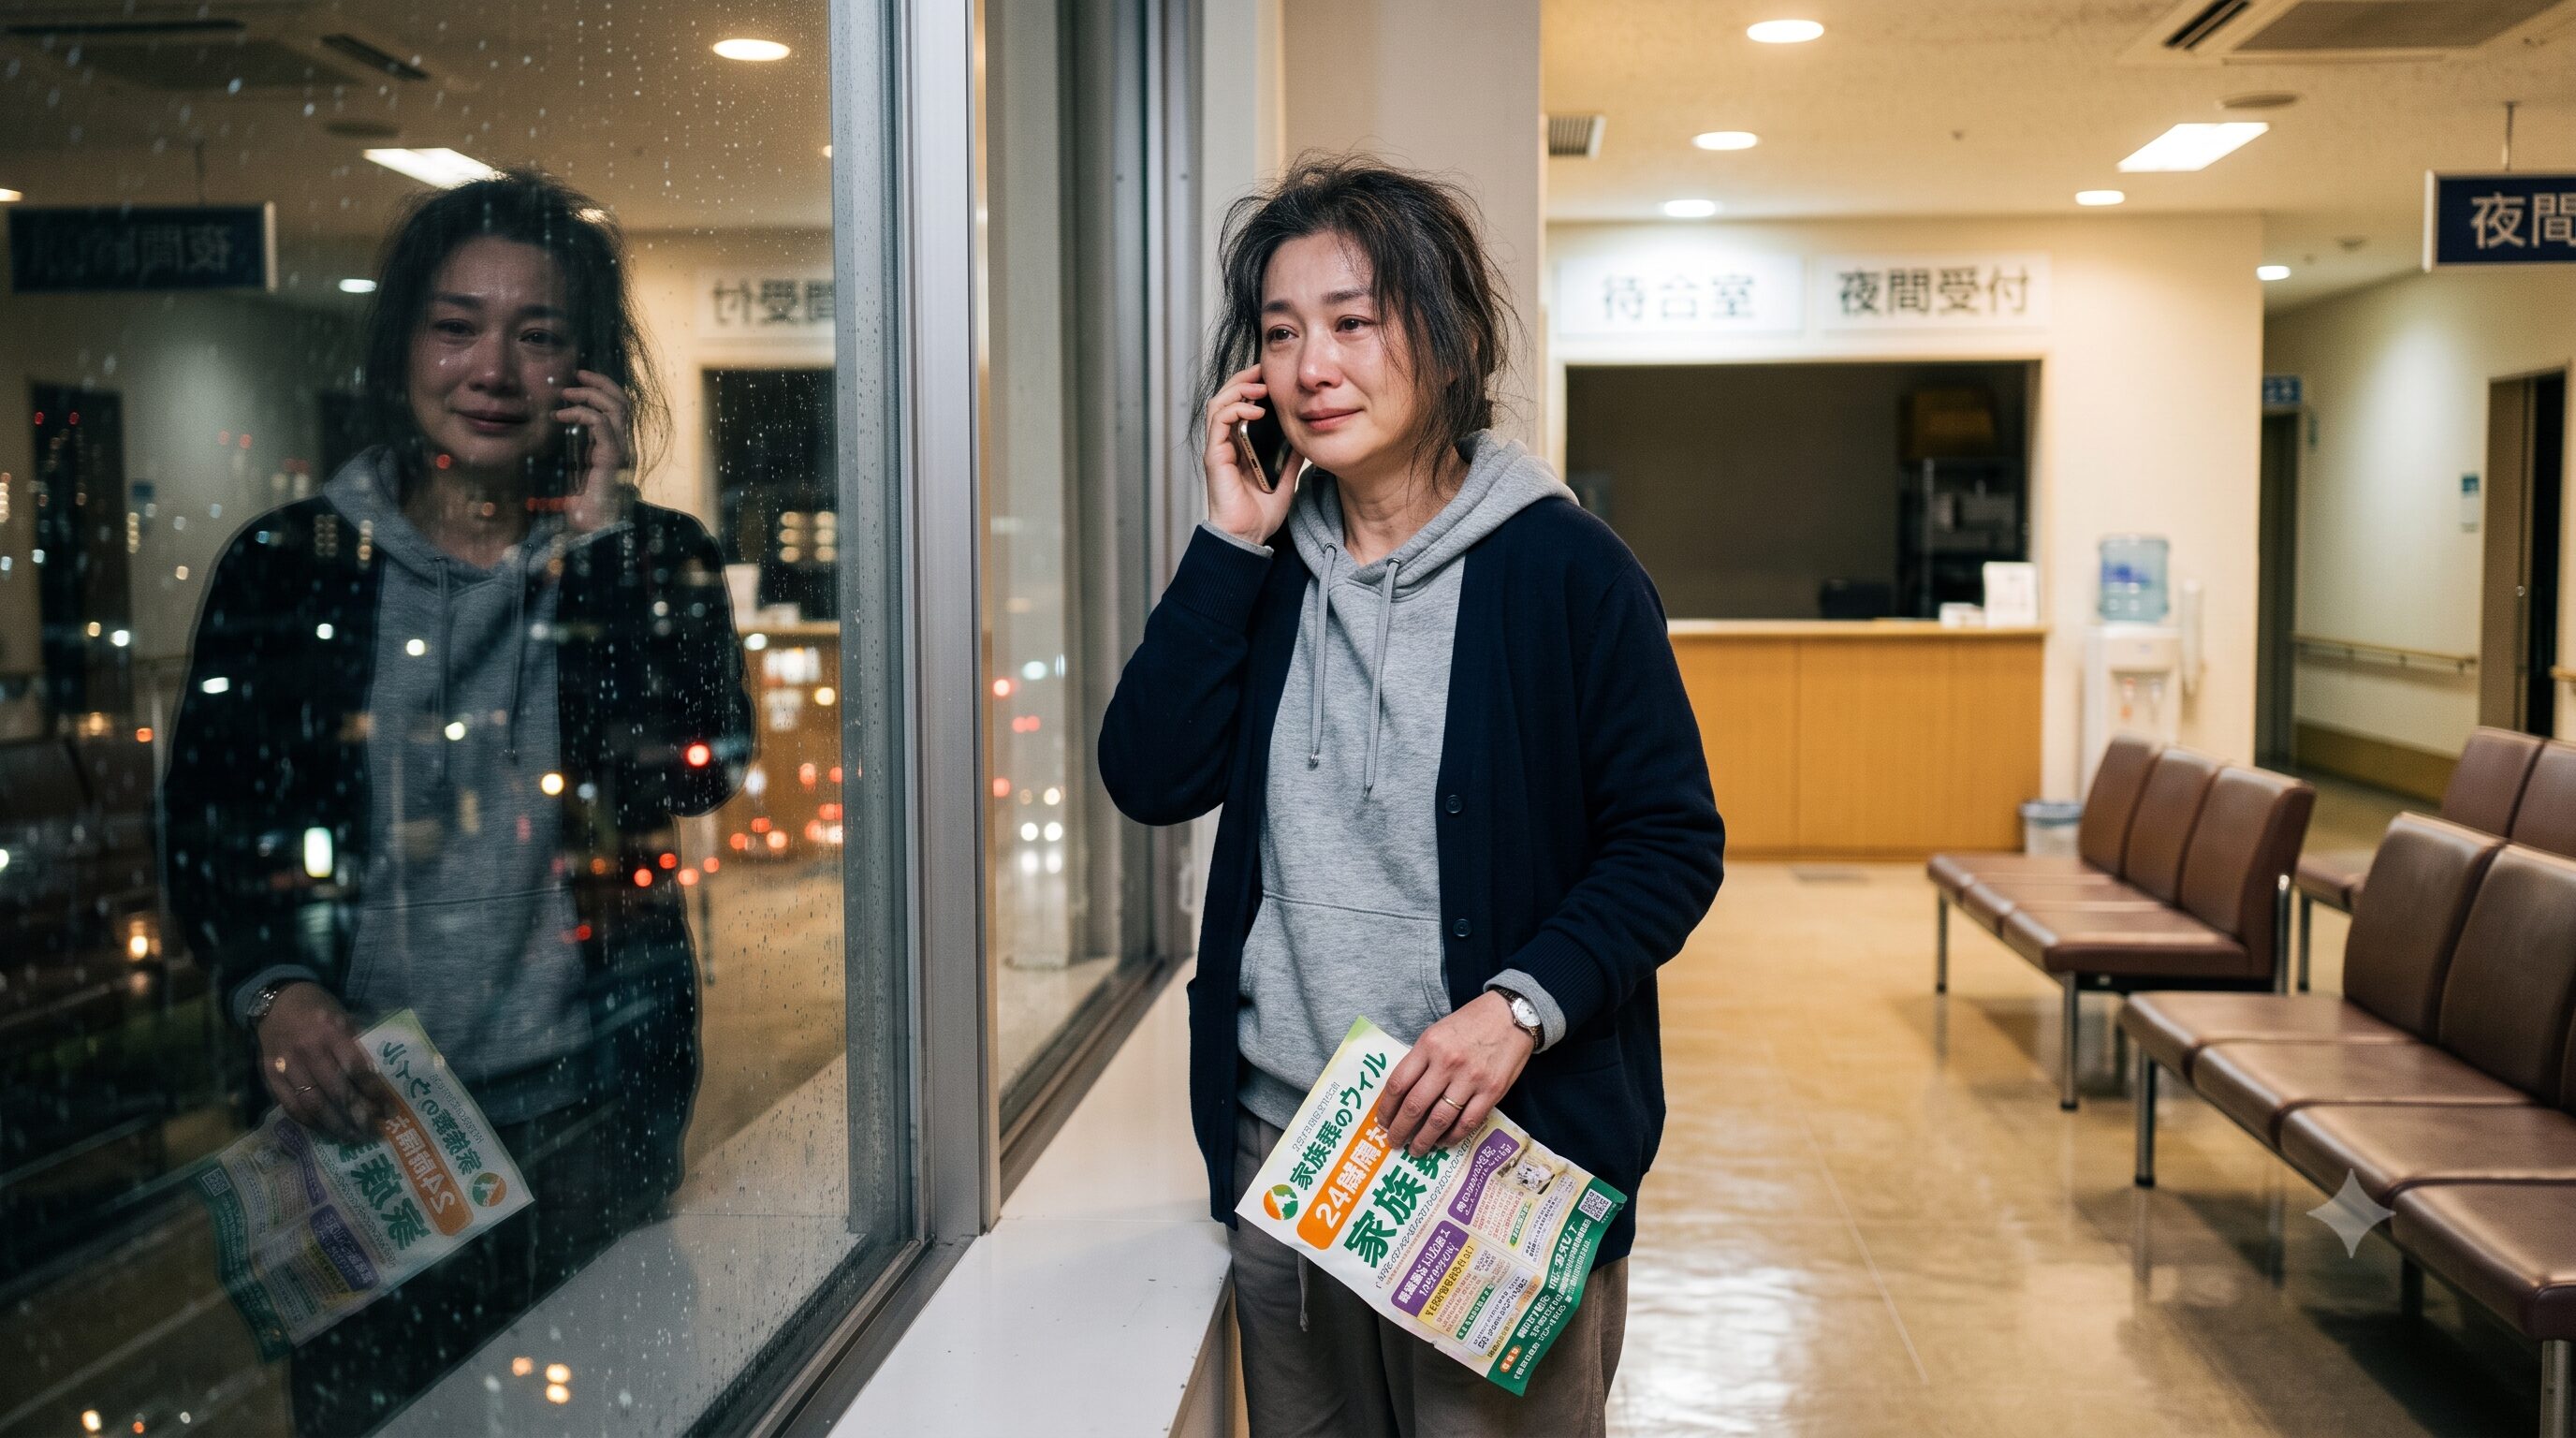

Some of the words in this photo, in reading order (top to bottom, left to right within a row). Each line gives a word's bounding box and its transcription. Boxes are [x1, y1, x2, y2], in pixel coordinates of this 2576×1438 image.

[2471, 192, 2576, 249] 夜間
[1838, 265, 2030, 316] 夜間受付
[1289, 1051, 1388, 1191] 家族葬のウィル
